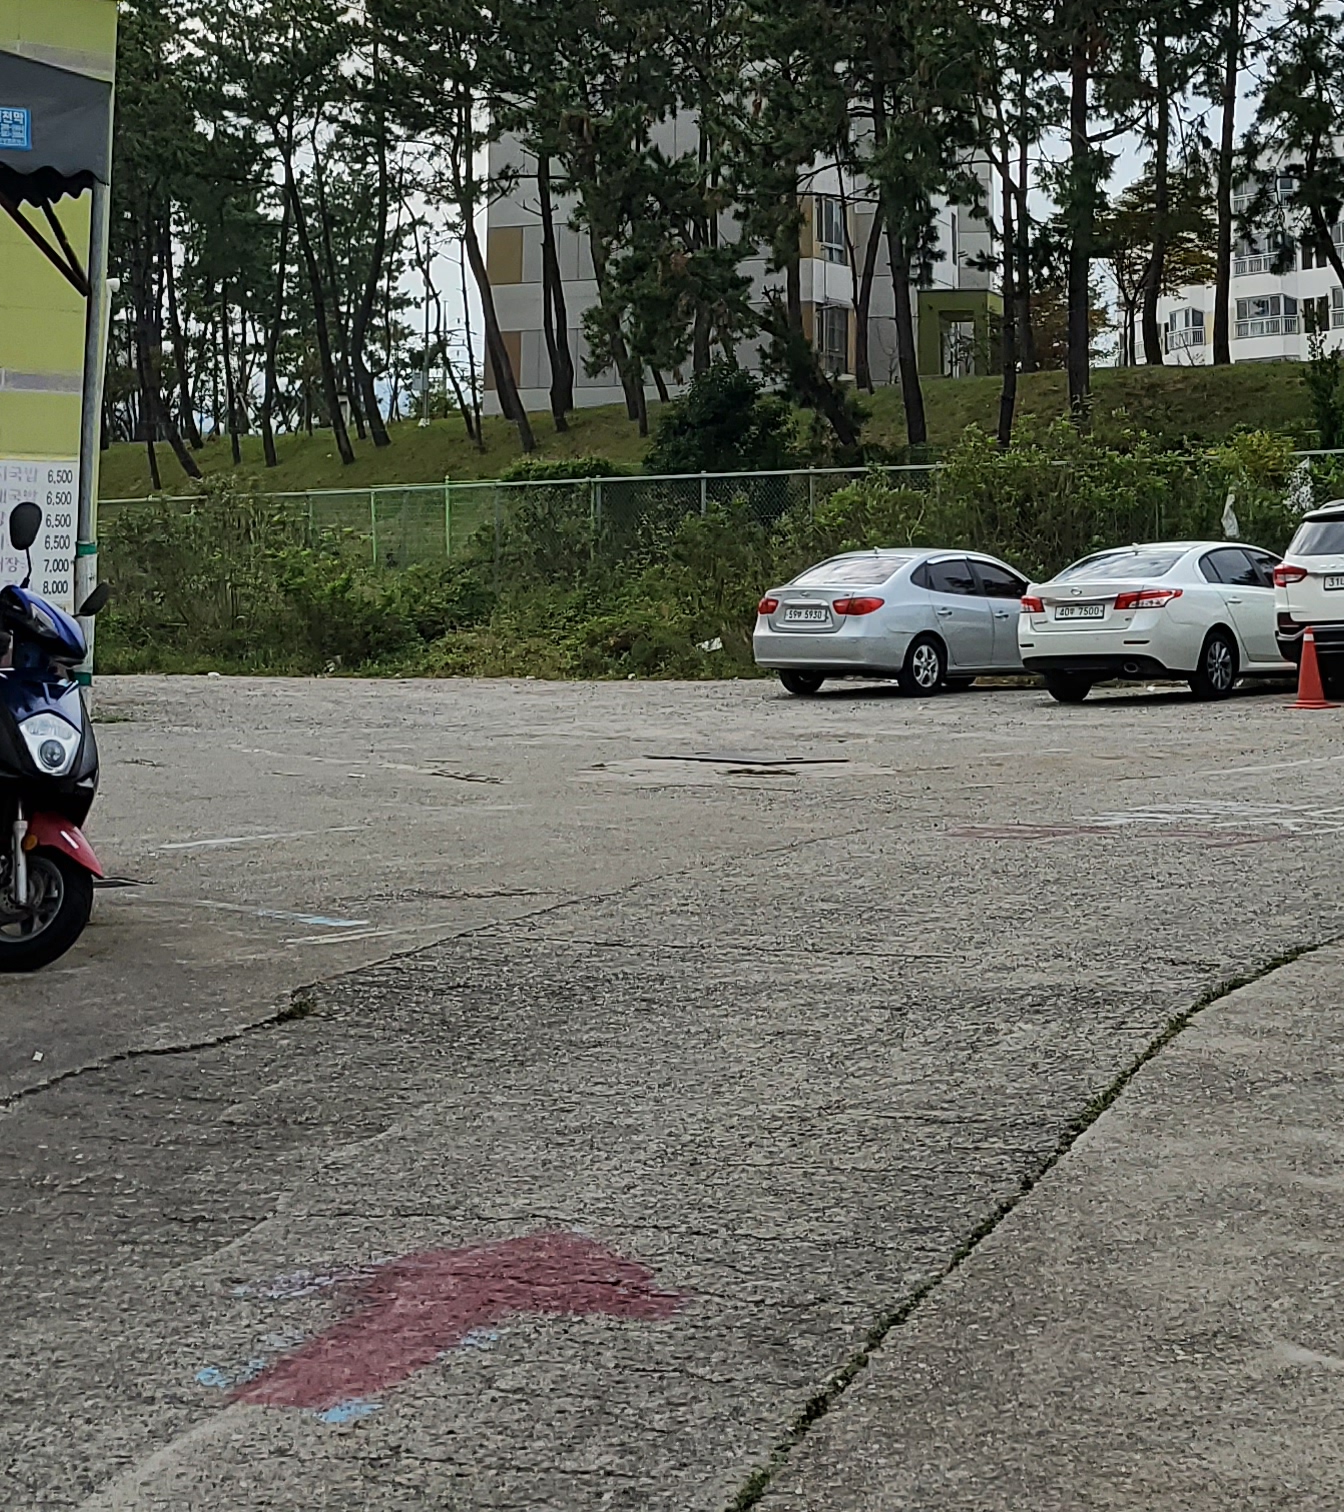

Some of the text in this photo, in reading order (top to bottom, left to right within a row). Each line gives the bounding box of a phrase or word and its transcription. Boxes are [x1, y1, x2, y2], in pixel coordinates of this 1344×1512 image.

[47, 469, 73, 484] 6,500
[46, 491, 72, 506] 6,500
[45, 513, 72, 529] 6,500
[44, 534, 71, 550] 6,500
[43, 559, 70, 574] 7,000
[42, 578, 69, 595] 8,000
